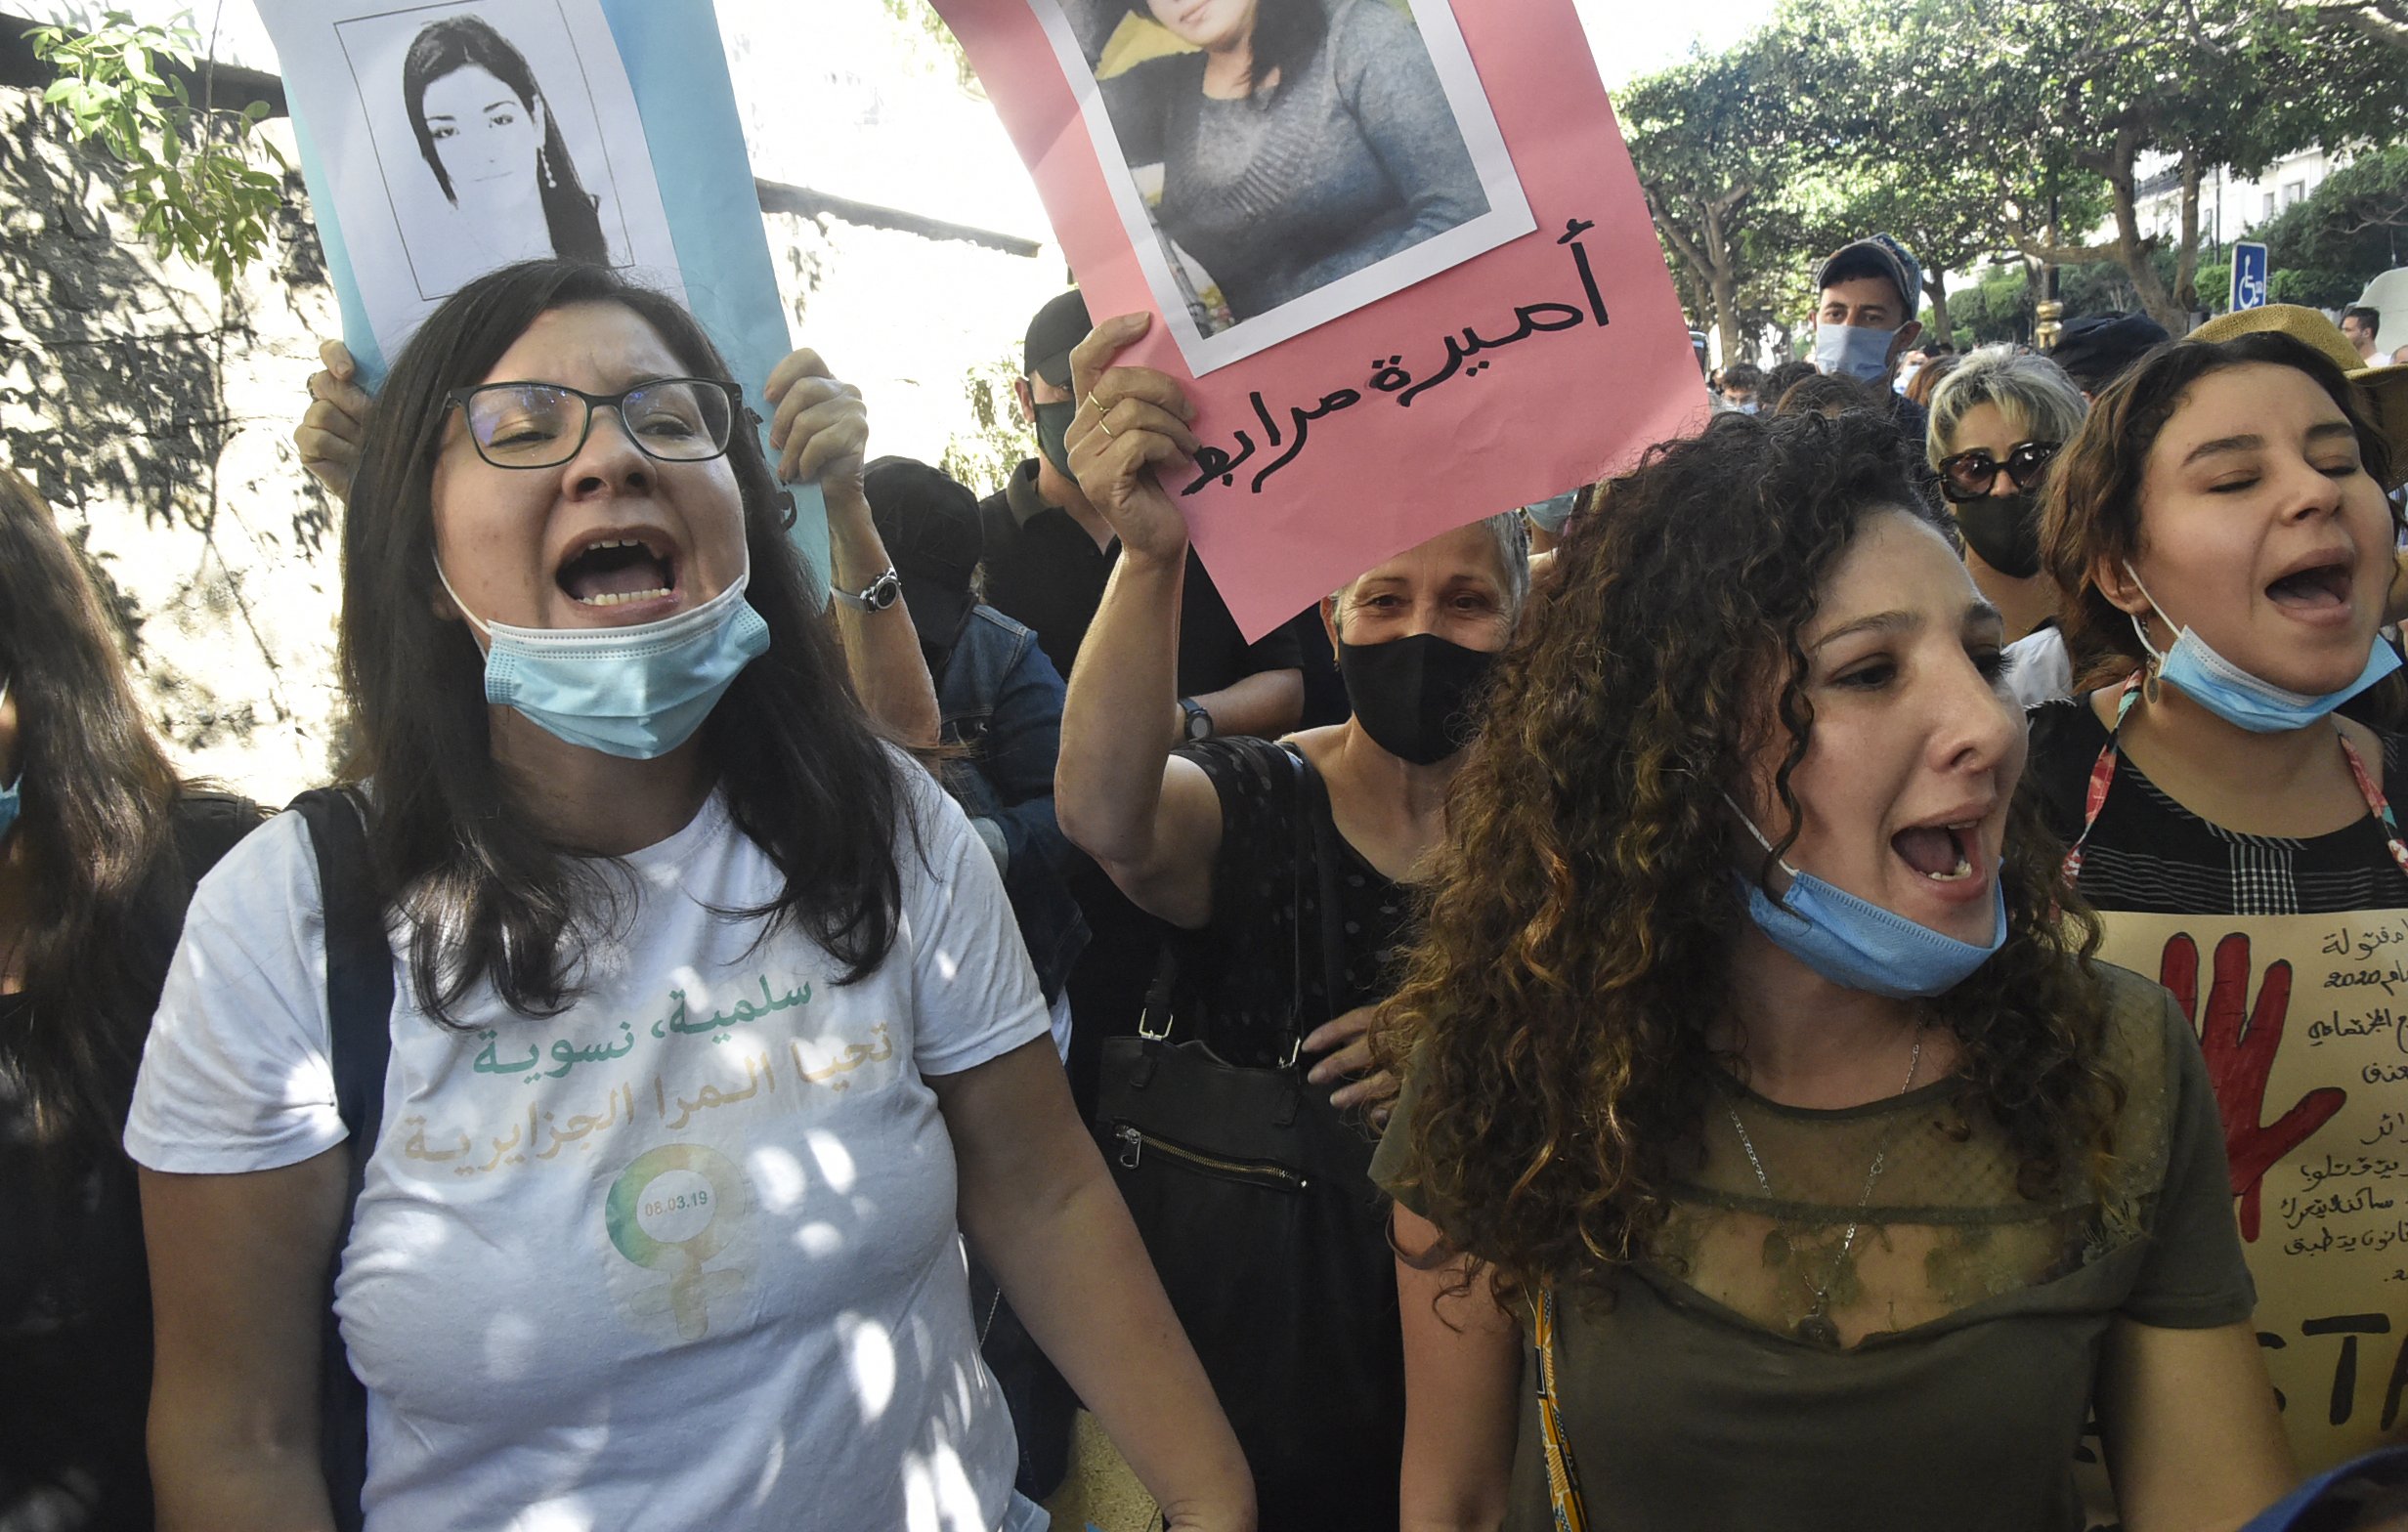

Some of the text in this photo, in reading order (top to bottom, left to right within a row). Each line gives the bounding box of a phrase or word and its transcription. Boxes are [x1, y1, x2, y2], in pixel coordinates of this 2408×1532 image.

[1368, 217, 1610, 407] أميرة
[2323, 968, 2382, 989] 2020
[472, 1020, 635, 1085] نسوية
[404, 1022, 894, 1176] تحيا المرا الجزايرية
[644, 1189, 709, 1217] 08.03.19
